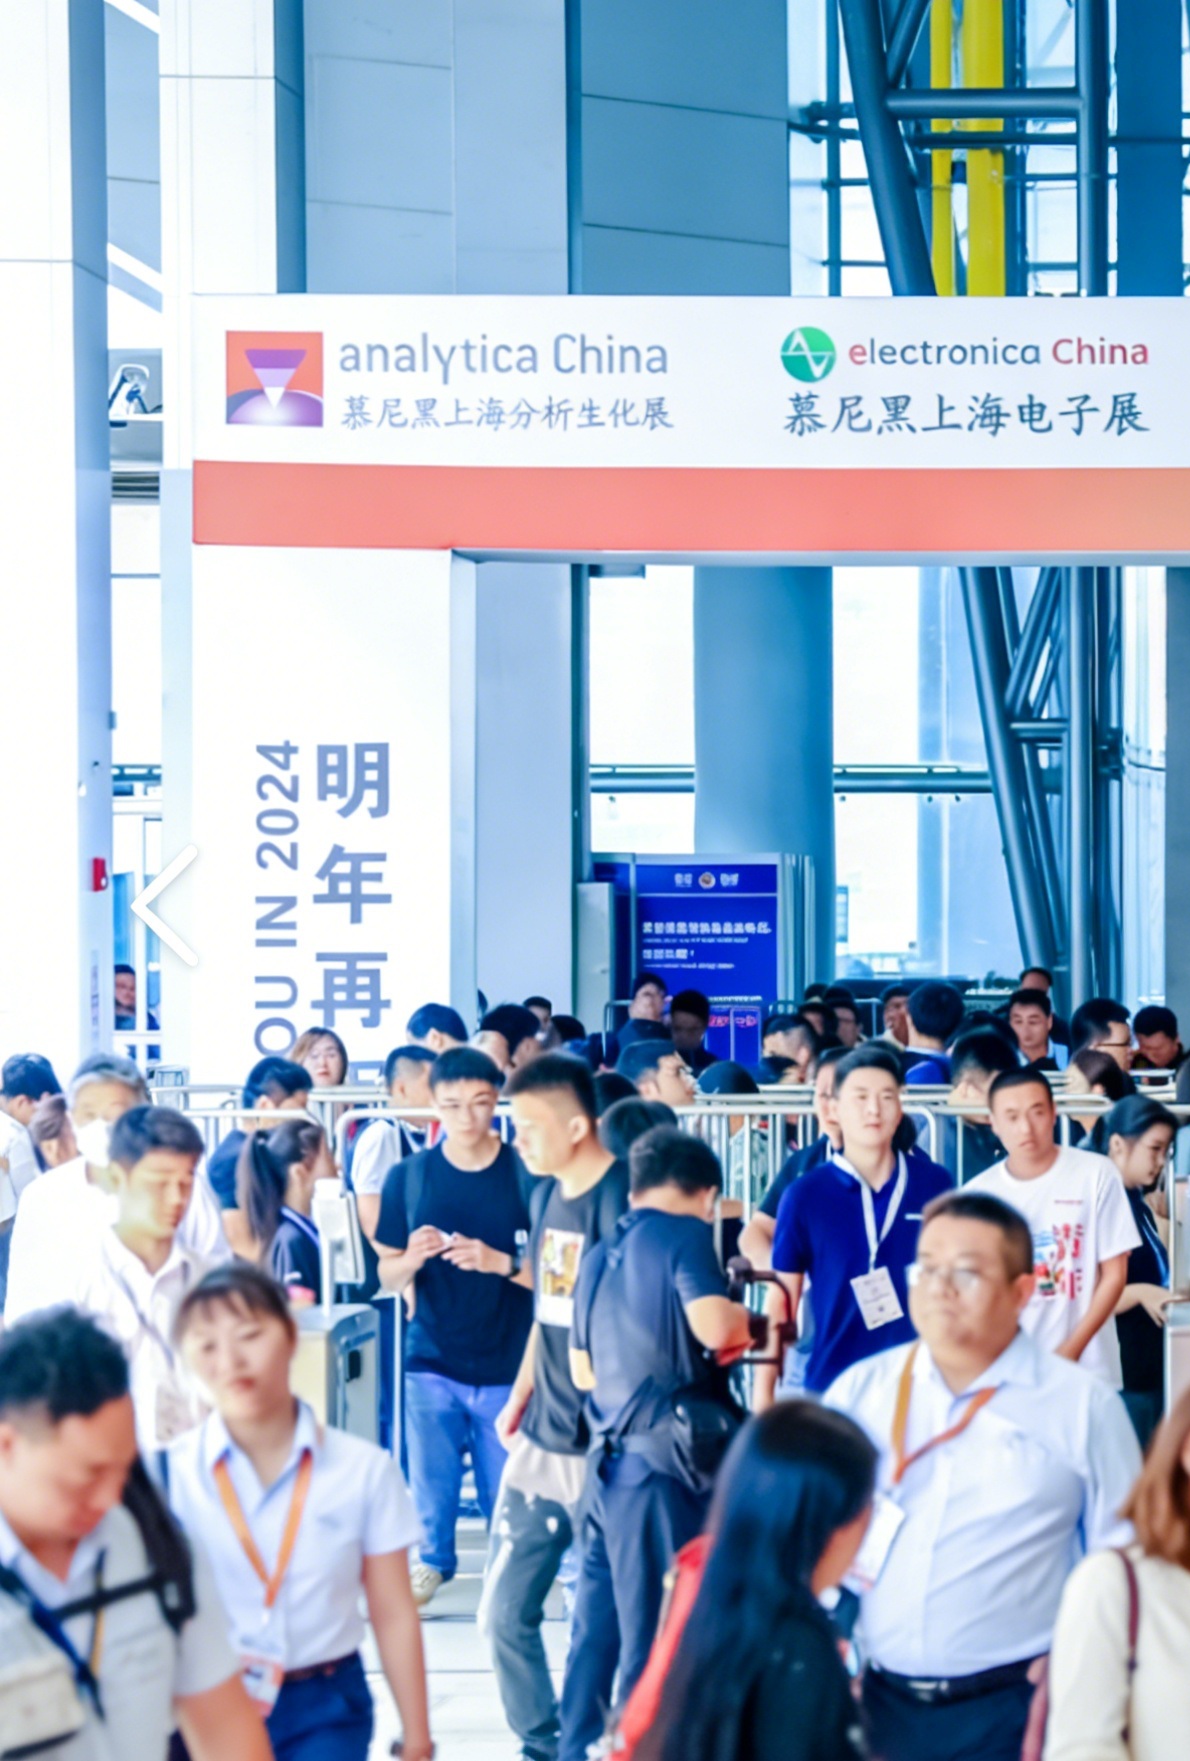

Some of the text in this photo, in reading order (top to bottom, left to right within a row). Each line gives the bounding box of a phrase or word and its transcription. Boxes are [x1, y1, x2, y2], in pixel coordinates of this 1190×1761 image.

[340, 332, 668, 385] analytica China
[848, 336, 1149, 366] electronica China
[342, 395, 674, 432] 慕尼黑上海分析生化展
[783, 390, 1151, 438] 慕尼黑上海电子展
[256, 740, 300, 871] 2024
[255, 896, 298, 947] IN
[310, 742, 392, 1086] 明年再
